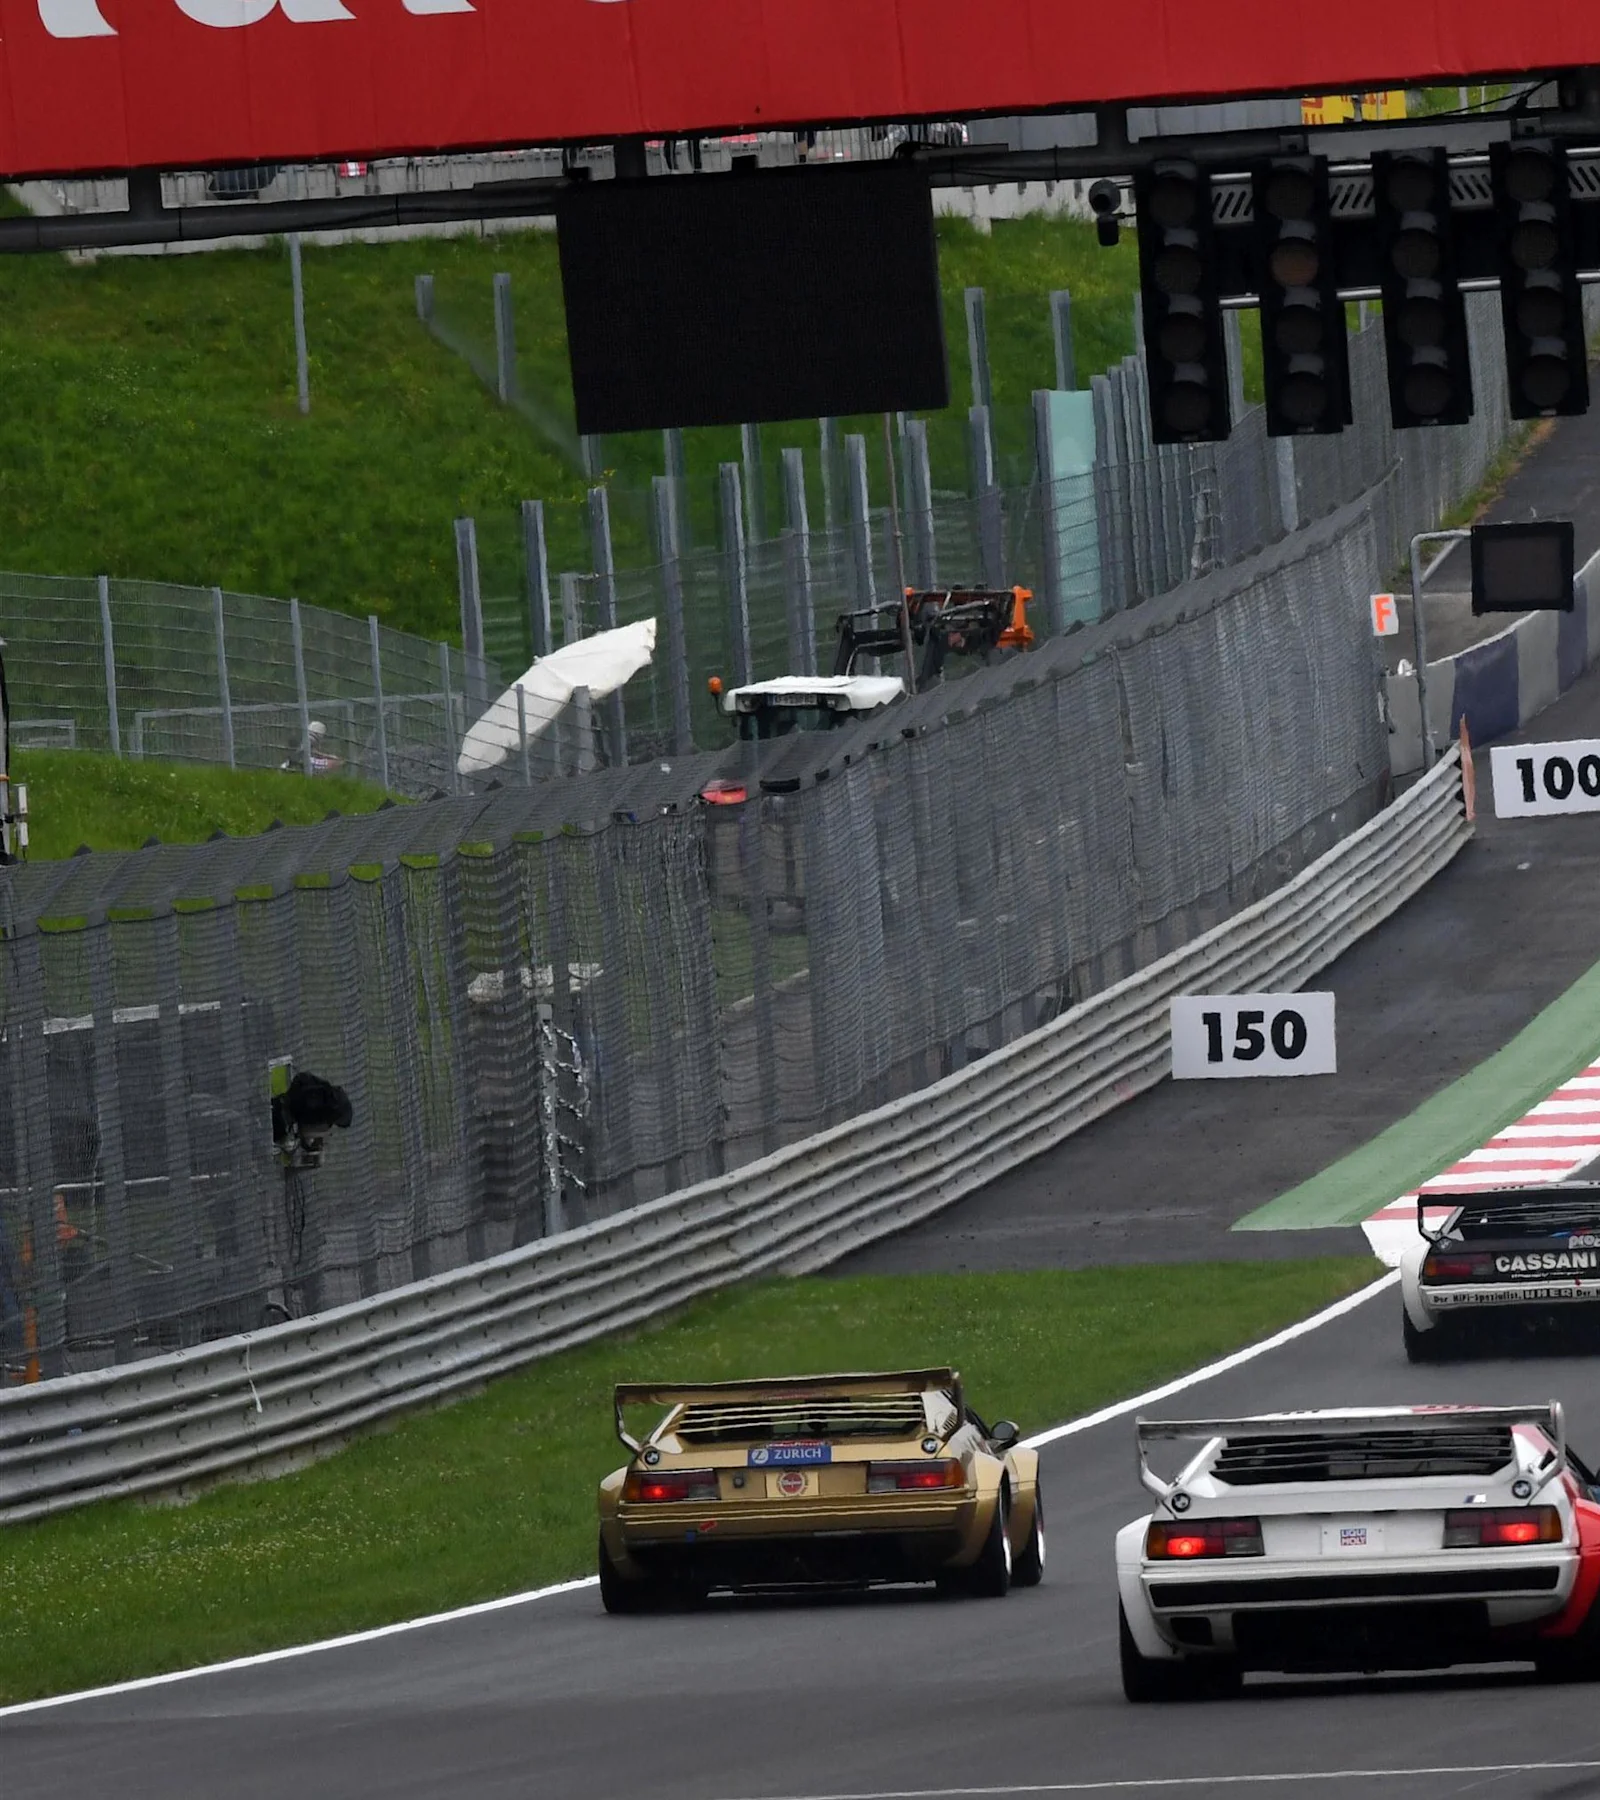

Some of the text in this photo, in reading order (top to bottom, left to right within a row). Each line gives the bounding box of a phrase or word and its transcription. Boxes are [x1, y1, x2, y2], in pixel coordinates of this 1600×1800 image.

[1374, 596, 1392, 632] F
[1202, 1010, 1307, 1063] 150
[1495, 1251, 1597, 1273] CASSANI
[1524, 1288, 1572, 1299] UHER
[774, 1448, 821, 1460] ZURICH
[1341, 1529, 1366, 1537] LIQUI
[1341, 1537, 1366, 1545] MOLY
